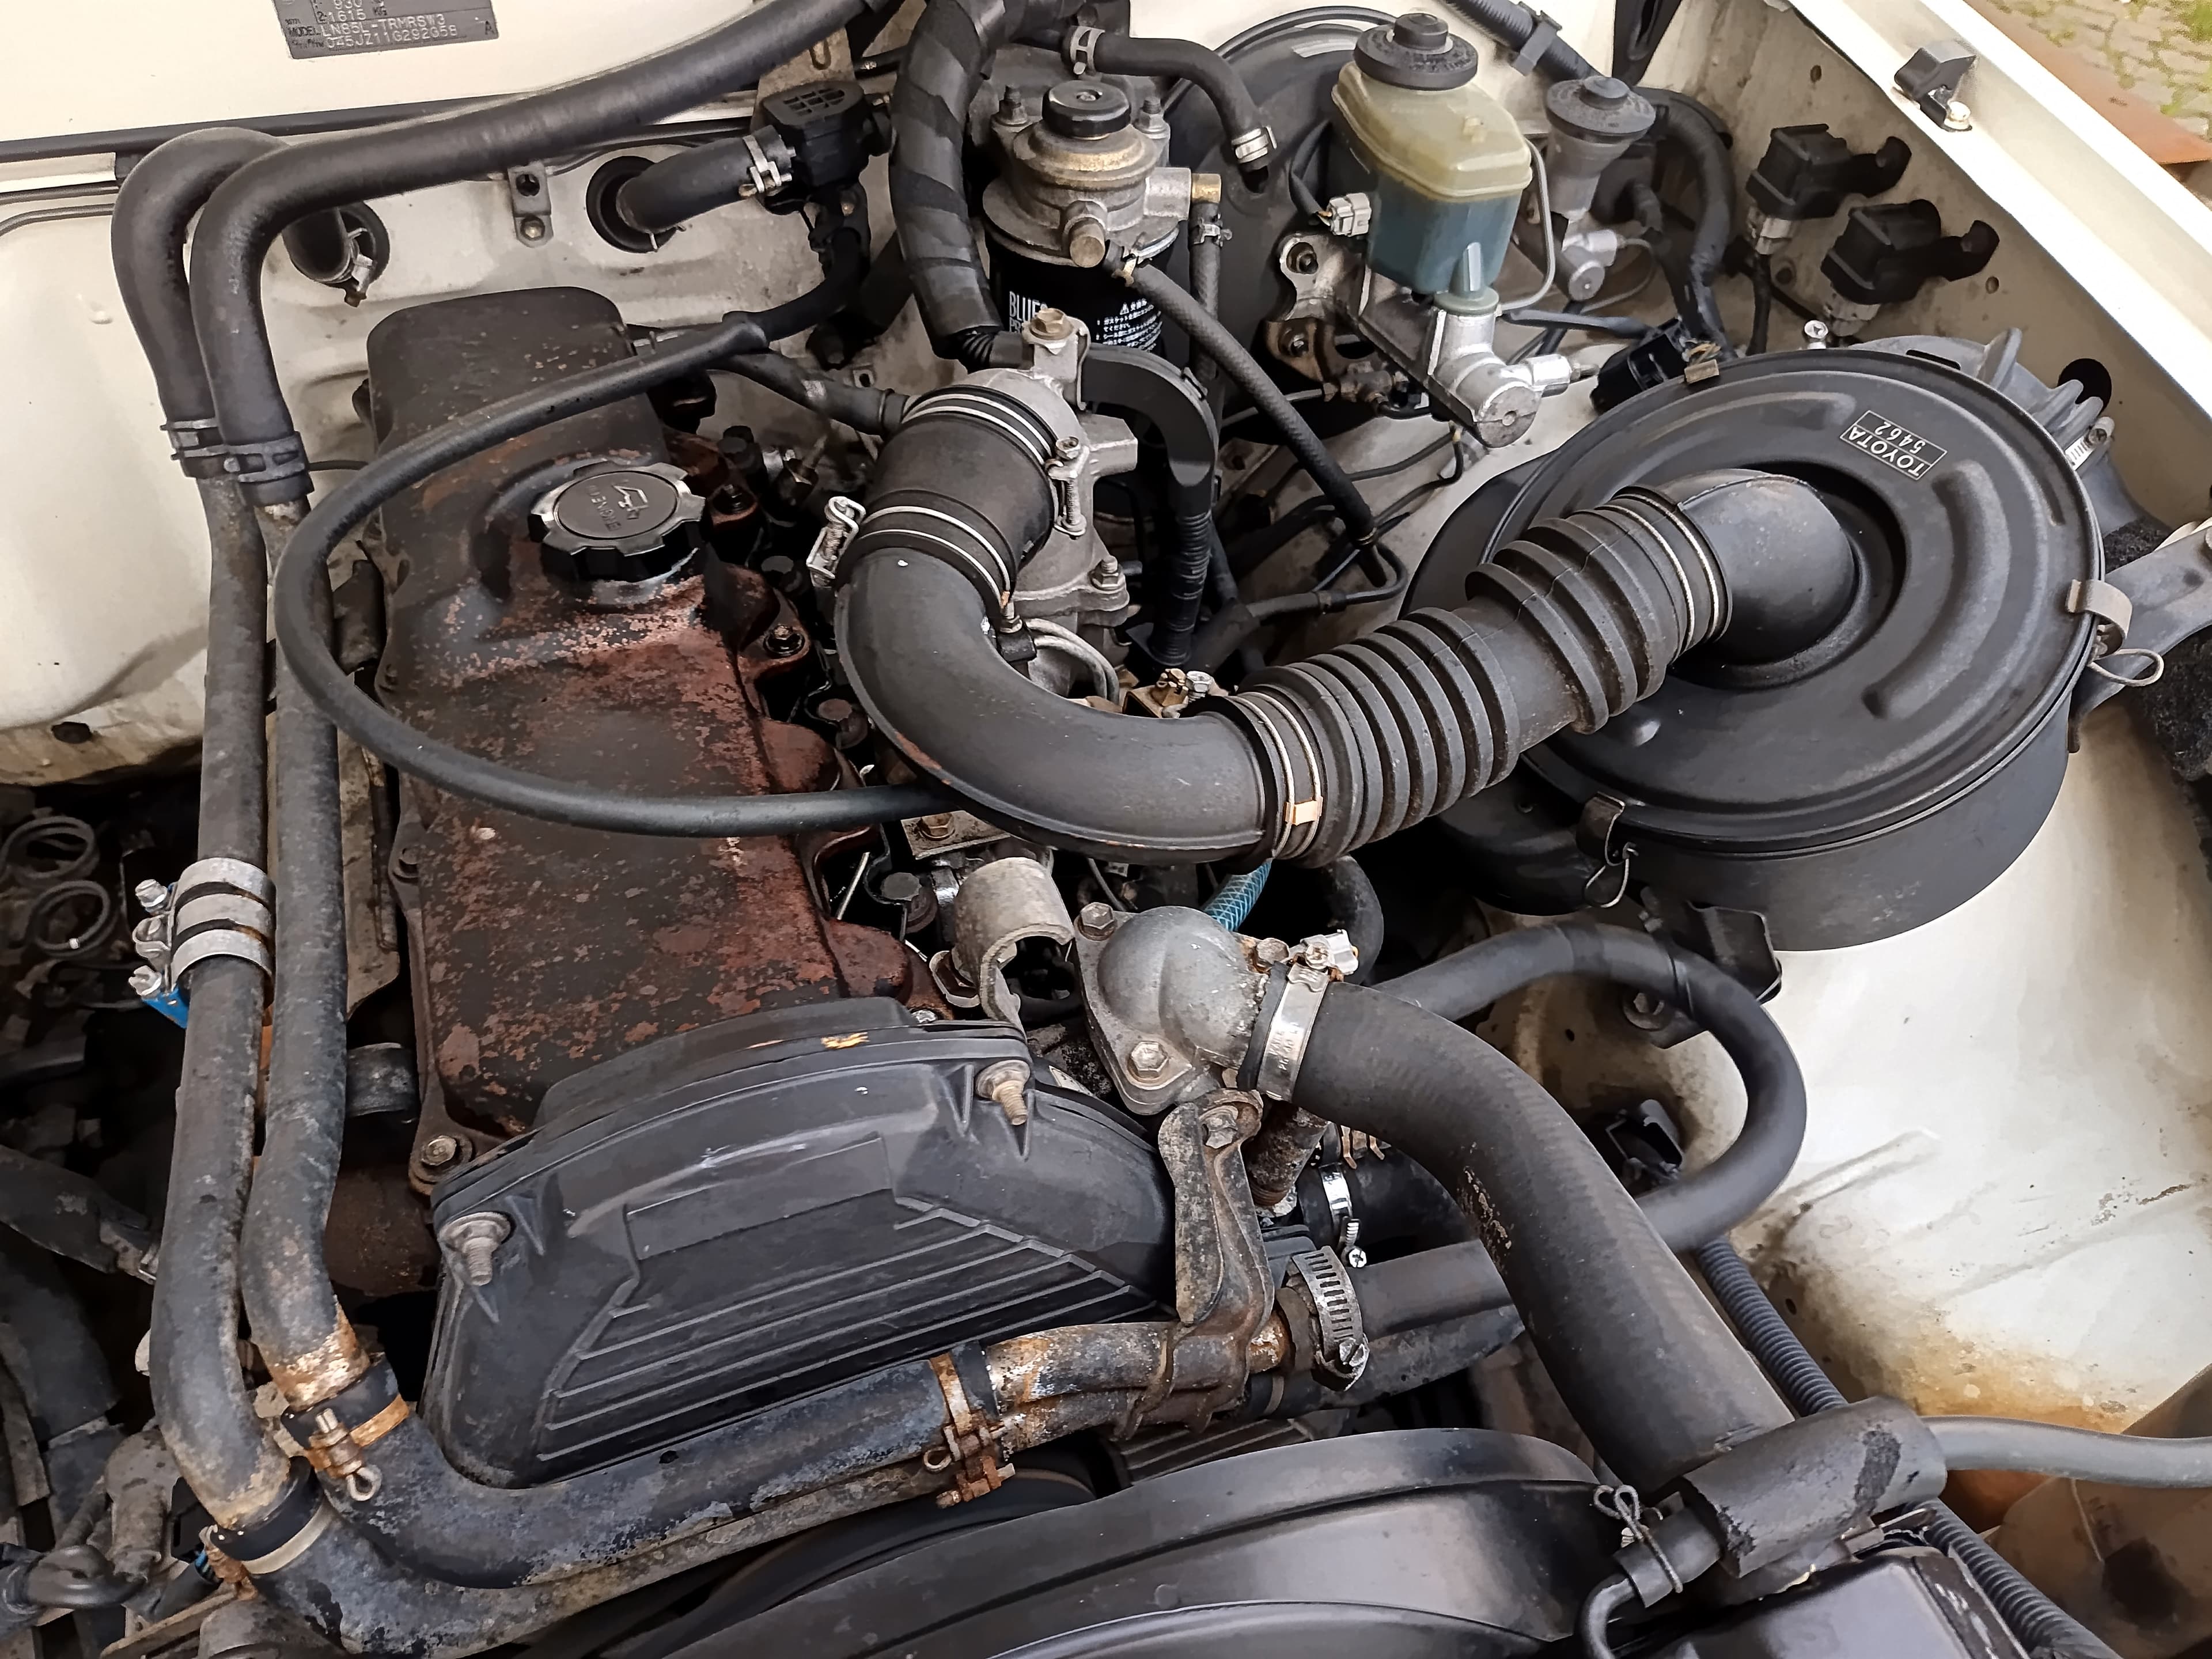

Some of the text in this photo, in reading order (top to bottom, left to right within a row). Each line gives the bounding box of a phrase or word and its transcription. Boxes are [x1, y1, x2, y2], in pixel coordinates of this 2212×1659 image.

[328, 9, 366, 22] 1615
[1849, 426, 1925, 476] TOYOTA
[1874, 421, 1926, 454] 5462
